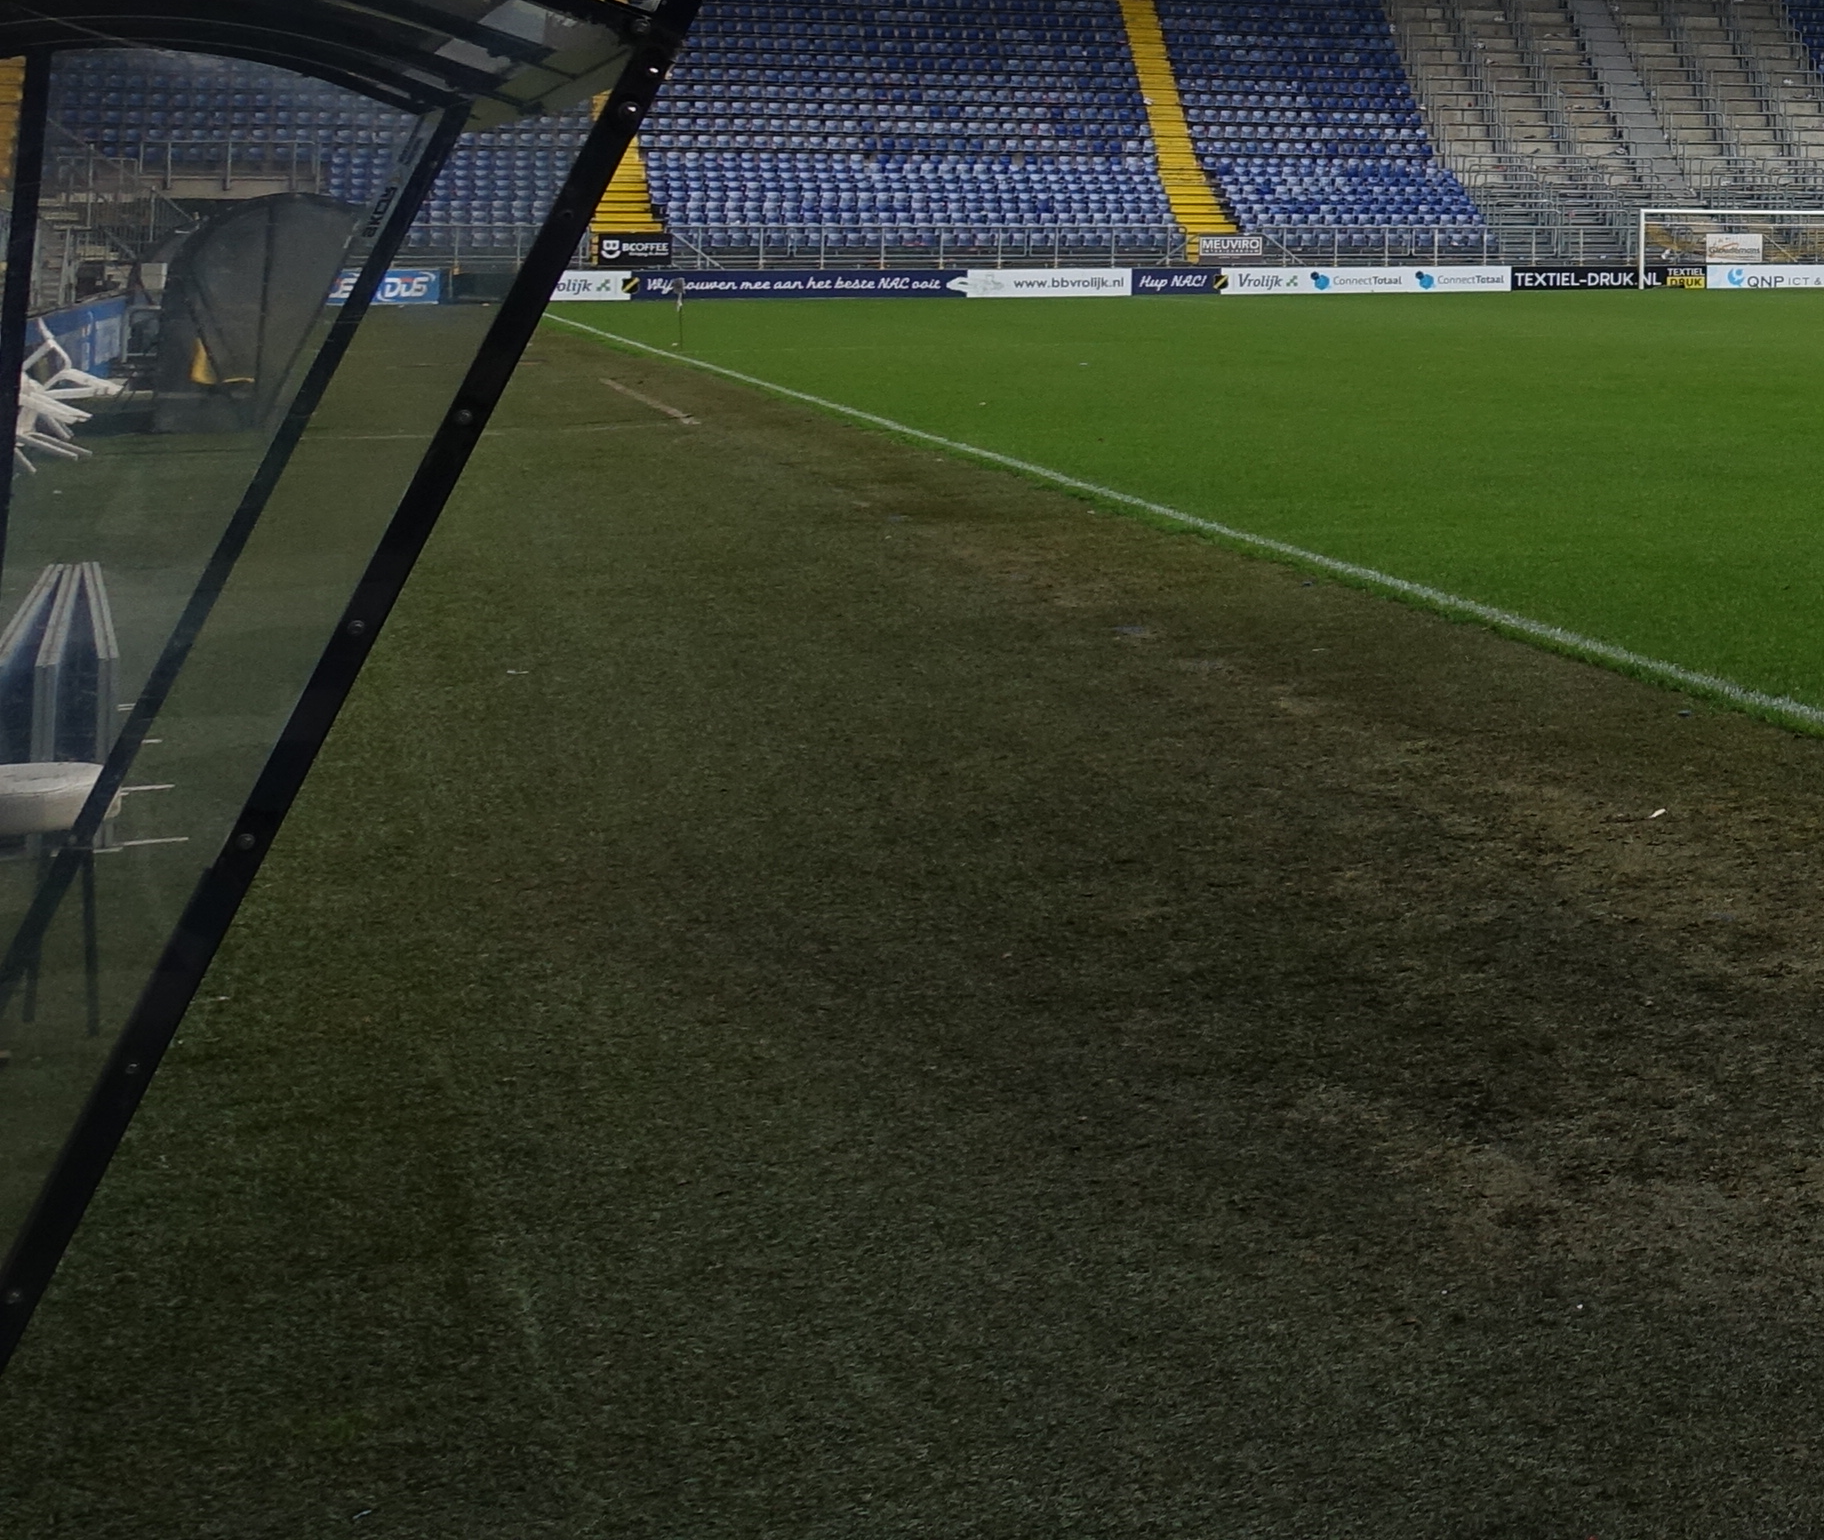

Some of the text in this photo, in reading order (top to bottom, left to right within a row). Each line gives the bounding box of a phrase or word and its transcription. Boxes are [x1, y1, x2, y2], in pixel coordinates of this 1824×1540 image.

[622, 242, 669, 251] BCOFFEE
[1202, 239, 1260, 249] MEUVIRO
[1667, 267, 1705, 277] TEXTIEL
[557, 277, 592, 294] olijk
[682, 278, 737, 289] ouwen
[740, 281, 769, 289] mee
[773, 280, 804, 289] aan
[805, 276, 832, 289] het
[834, 276, 875, 290] beste
[877, 277, 910, 290] NAC
[911, 276, 941, 290] ooit
[1014, 276, 1124, 292] www.bbvrolijk.nl
[1138, 274, 1208, 291] Hup NAC!
[1238, 273, 1283, 290] Vrolijk
[1333, 275, 1402, 286] ConnectTotaal
[1437, 274, 1504, 285] ConnectTotaal
[1670, 277, 1704, 288] DRUK
[1747, 275, 1784, 288] QNP
[1788, 277, 1811, 286] ICT
[1814, 277, 1822, 286] &
